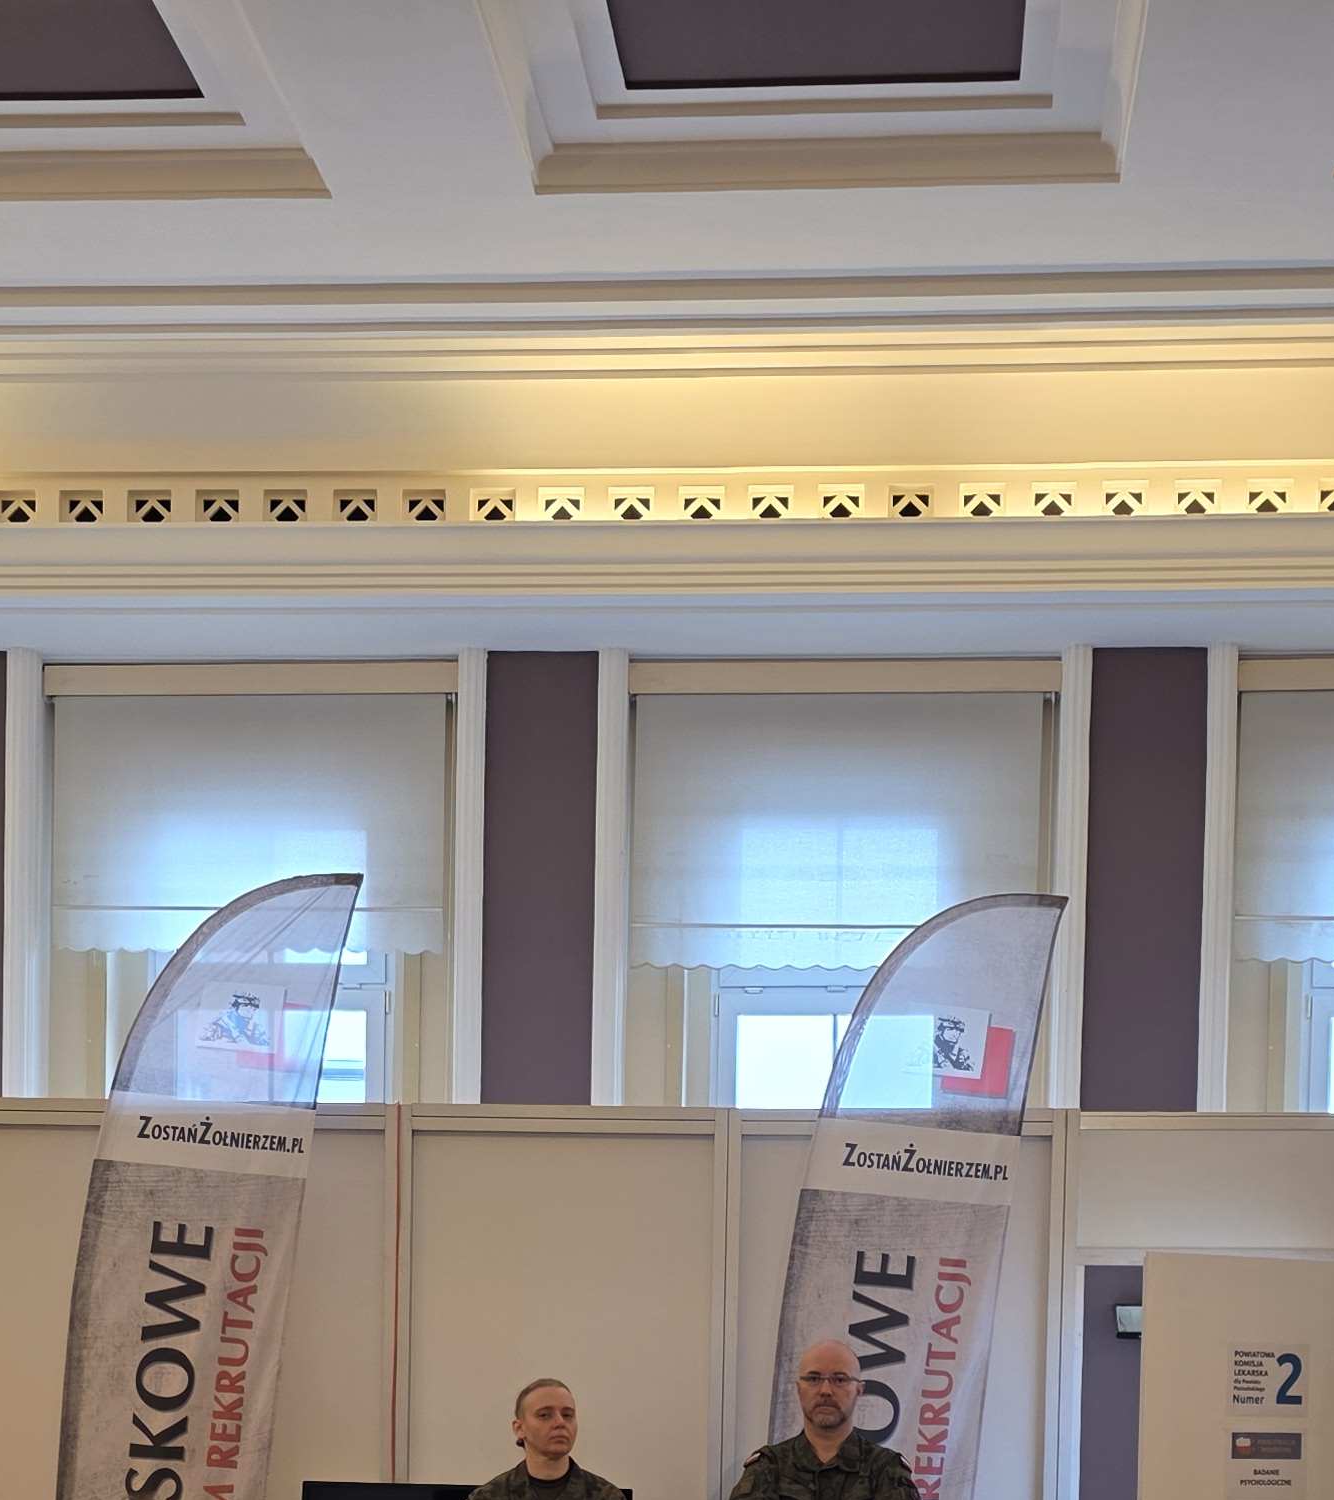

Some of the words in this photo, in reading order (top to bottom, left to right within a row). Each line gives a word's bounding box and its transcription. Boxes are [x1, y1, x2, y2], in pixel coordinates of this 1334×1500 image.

[205, 1227, 269, 1470] REKRUTACJI
[1234, 1350, 1276, 1359] POWIATOWA
[1234, 1360, 1264, 1368] KOMISJA
[915, 1256, 972, 1500] REKRUTACJI
[1233, 1394, 1265, 1405] Numer
[1276, 1352, 1303, 1405] 2
[1234, 1369, 1269, 1377] LEKARSKA
